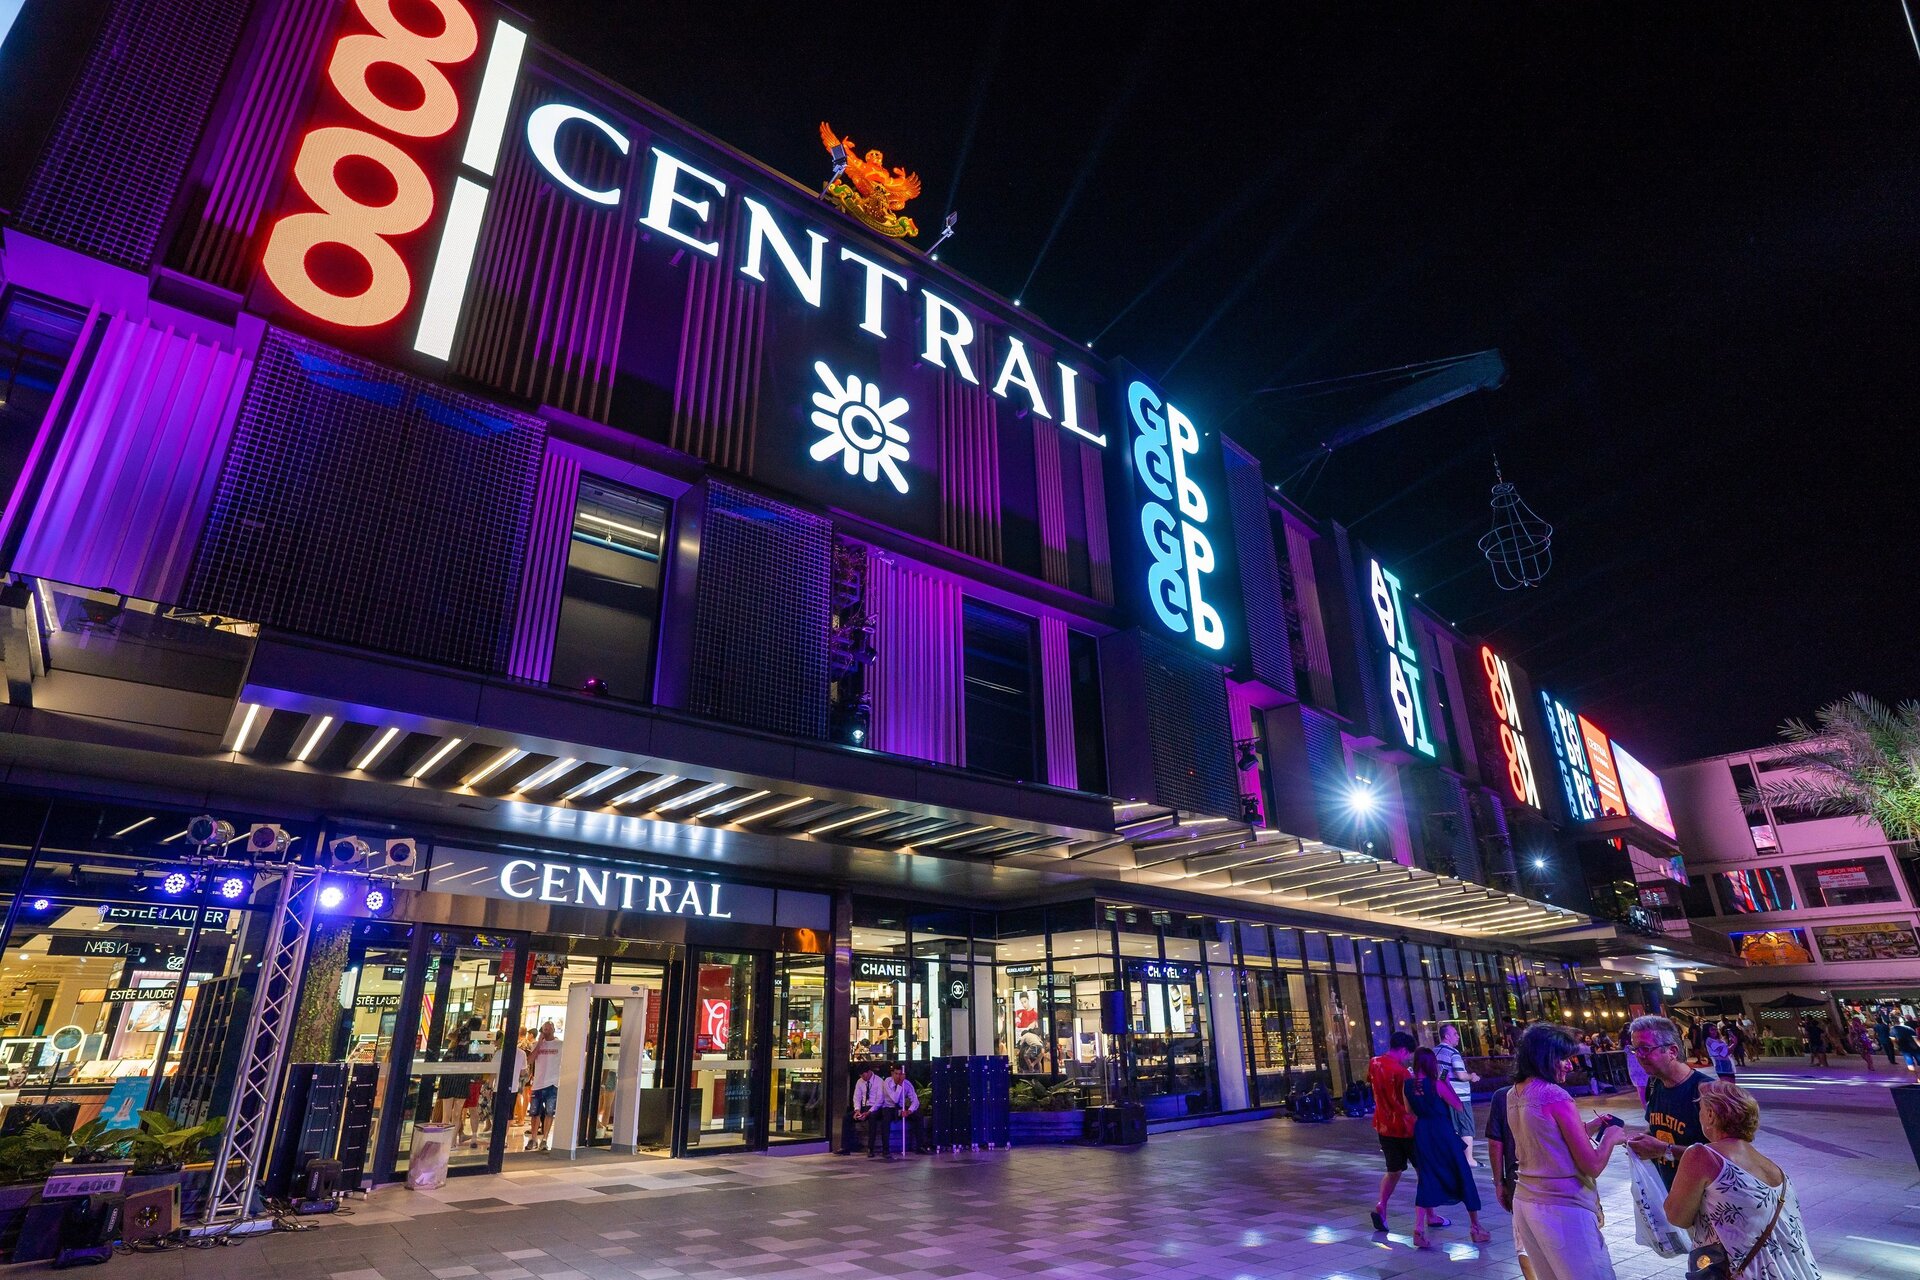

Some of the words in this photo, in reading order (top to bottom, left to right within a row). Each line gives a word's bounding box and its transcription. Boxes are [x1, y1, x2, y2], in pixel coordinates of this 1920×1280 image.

[527, 103, 1106, 447] CENTRAL
[500, 860, 732, 919] CENTRAL
[162, 908, 223, 923] LAUER
[860, 962, 907, 977] CHANEL
[137, 988, 175, 1000] LAUDER
